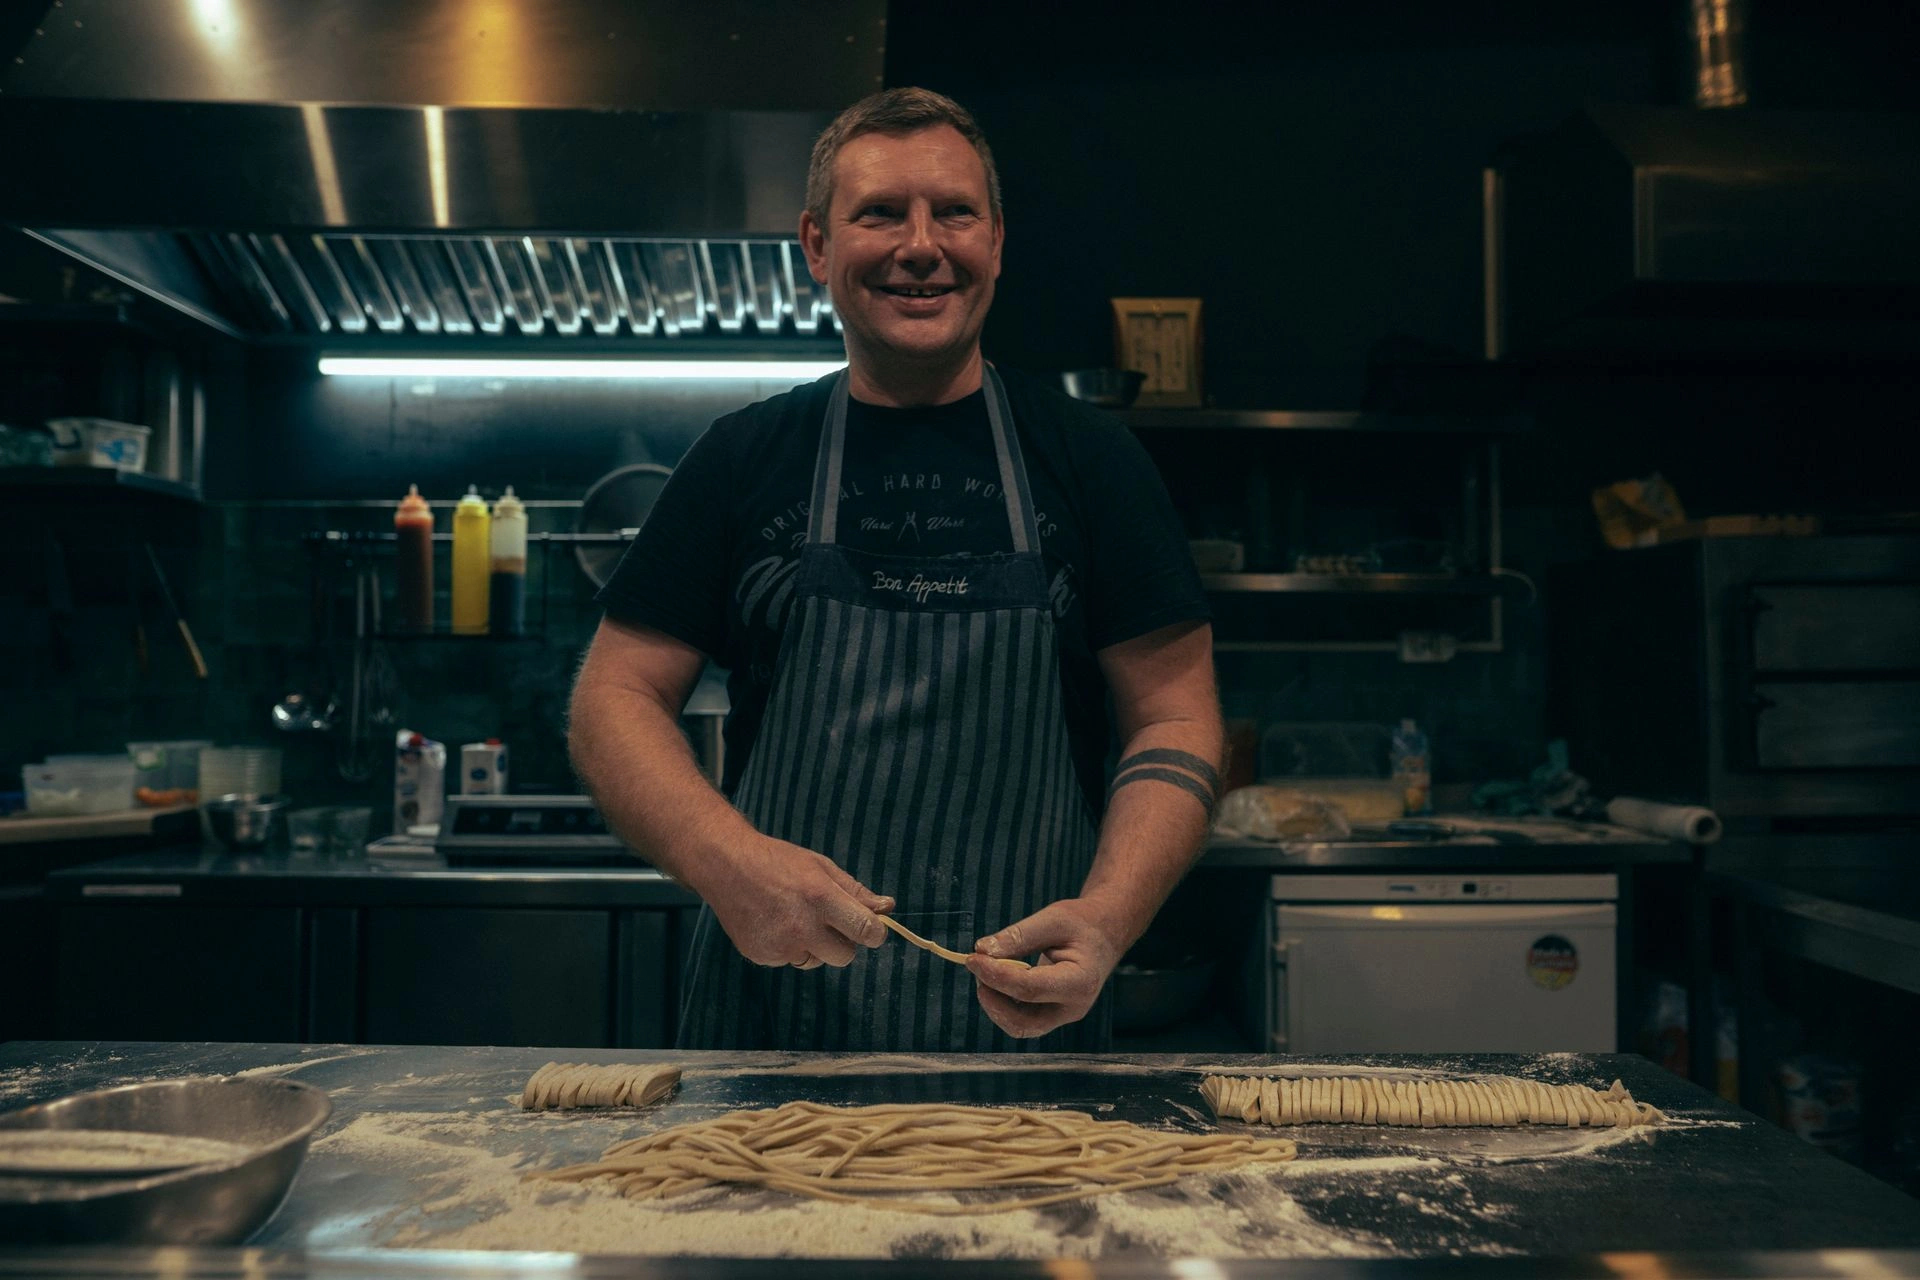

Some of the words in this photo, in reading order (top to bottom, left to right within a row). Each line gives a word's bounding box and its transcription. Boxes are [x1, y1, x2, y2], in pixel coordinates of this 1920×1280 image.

[761, 480, 865, 541] ORIGAL
[883, 473, 941, 493] HARD
[872, 570, 904, 591] Bon
[906, 573, 969, 604] Appetit
